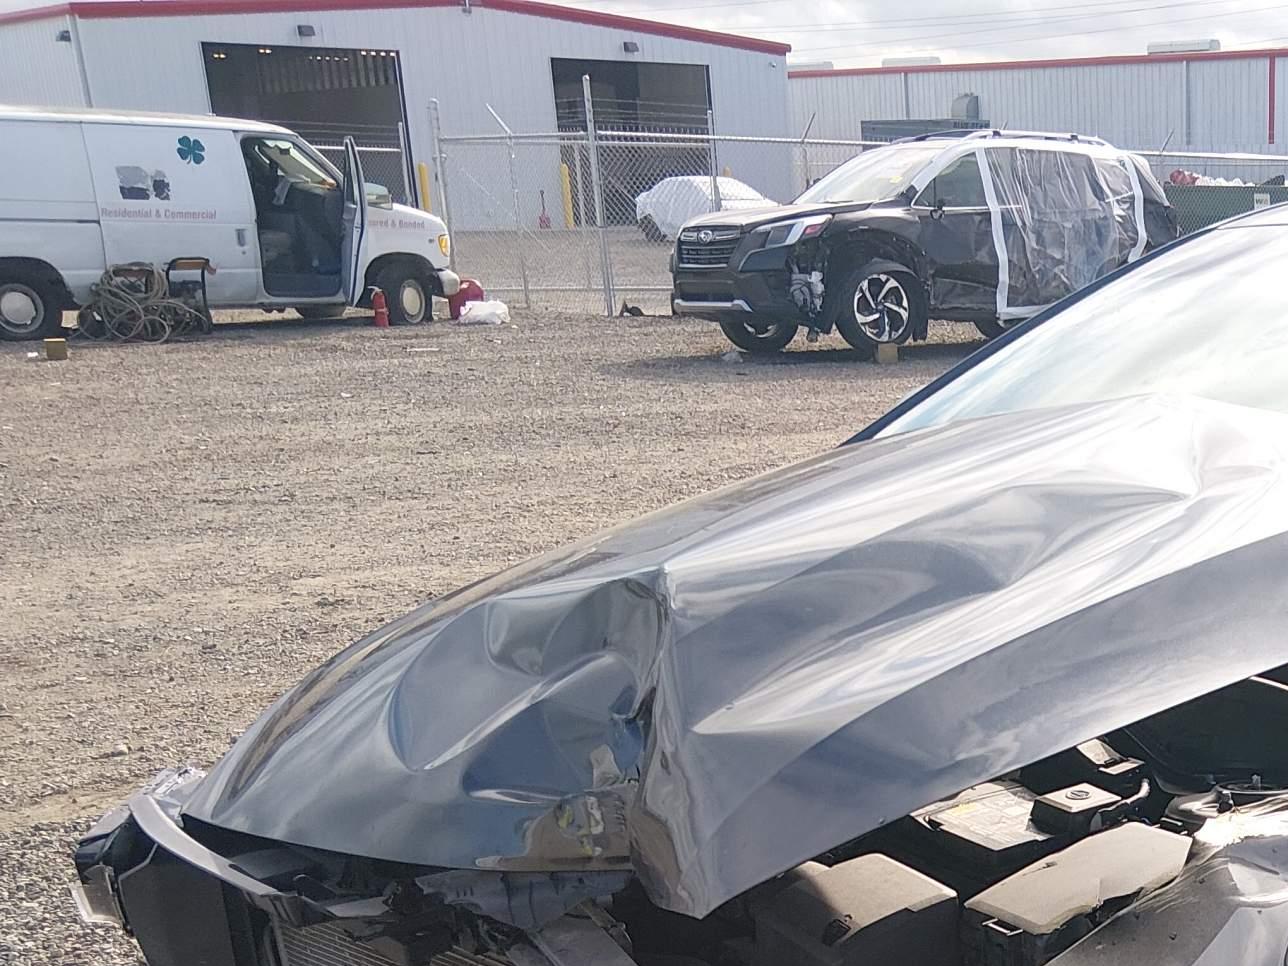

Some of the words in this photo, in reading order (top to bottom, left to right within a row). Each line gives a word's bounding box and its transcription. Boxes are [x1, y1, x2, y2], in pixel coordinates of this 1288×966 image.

[101, 207, 152, 219] Residential
[154, 208, 161, 218] &
[164, 208, 217, 220] Commercial
